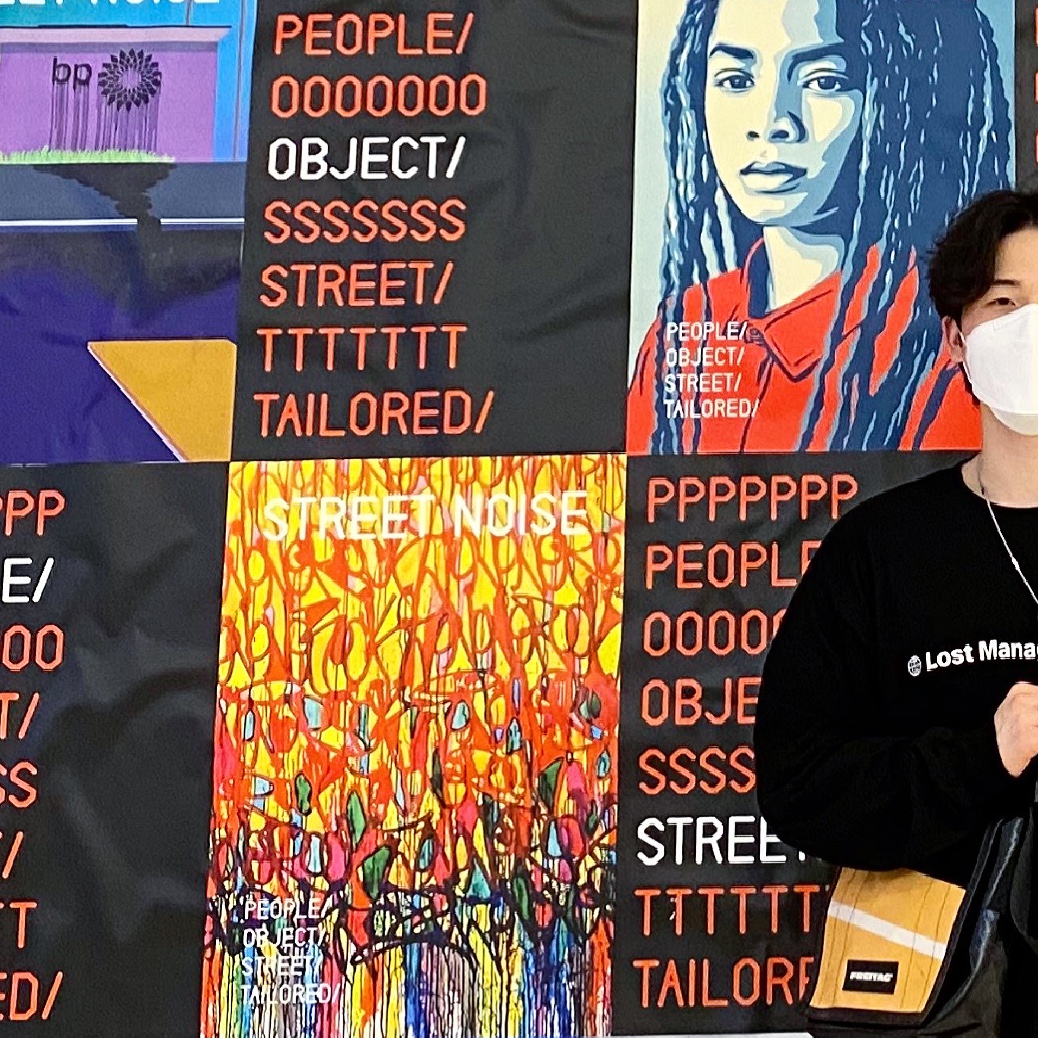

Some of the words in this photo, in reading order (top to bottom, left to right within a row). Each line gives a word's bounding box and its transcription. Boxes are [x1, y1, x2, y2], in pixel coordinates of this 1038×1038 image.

[275, 12, 474, 55] PEOPLE/
[52, 55, 92, 91] bp
[268, 136, 466, 181] OBJECT/
[264, 200, 467, 243] SSSSSSS
[260, 261, 453, 307] STREET/
[257, 325, 468, 371] TTTTTTT
[666, 321, 748, 342] PEOPLE/
[666, 346, 745, 367] OBJECT/
[664, 372, 742, 393] STREET/
[253, 390, 494, 437] TAILORED/
[663, 398, 760, 419] TAILORED/
[263, 494, 435, 541] STREET
[454, 490, 588, 537] NOISE
[647, 474, 858, 523] PPPPPPP
[643, 609, 787, 657] OOOO
[926, 643, 974, 672] Lost
[637, 815, 806, 866] STREE
[244, 898, 333, 920] PEOPLE/
[634, 885, 829, 936] TTTTTT
